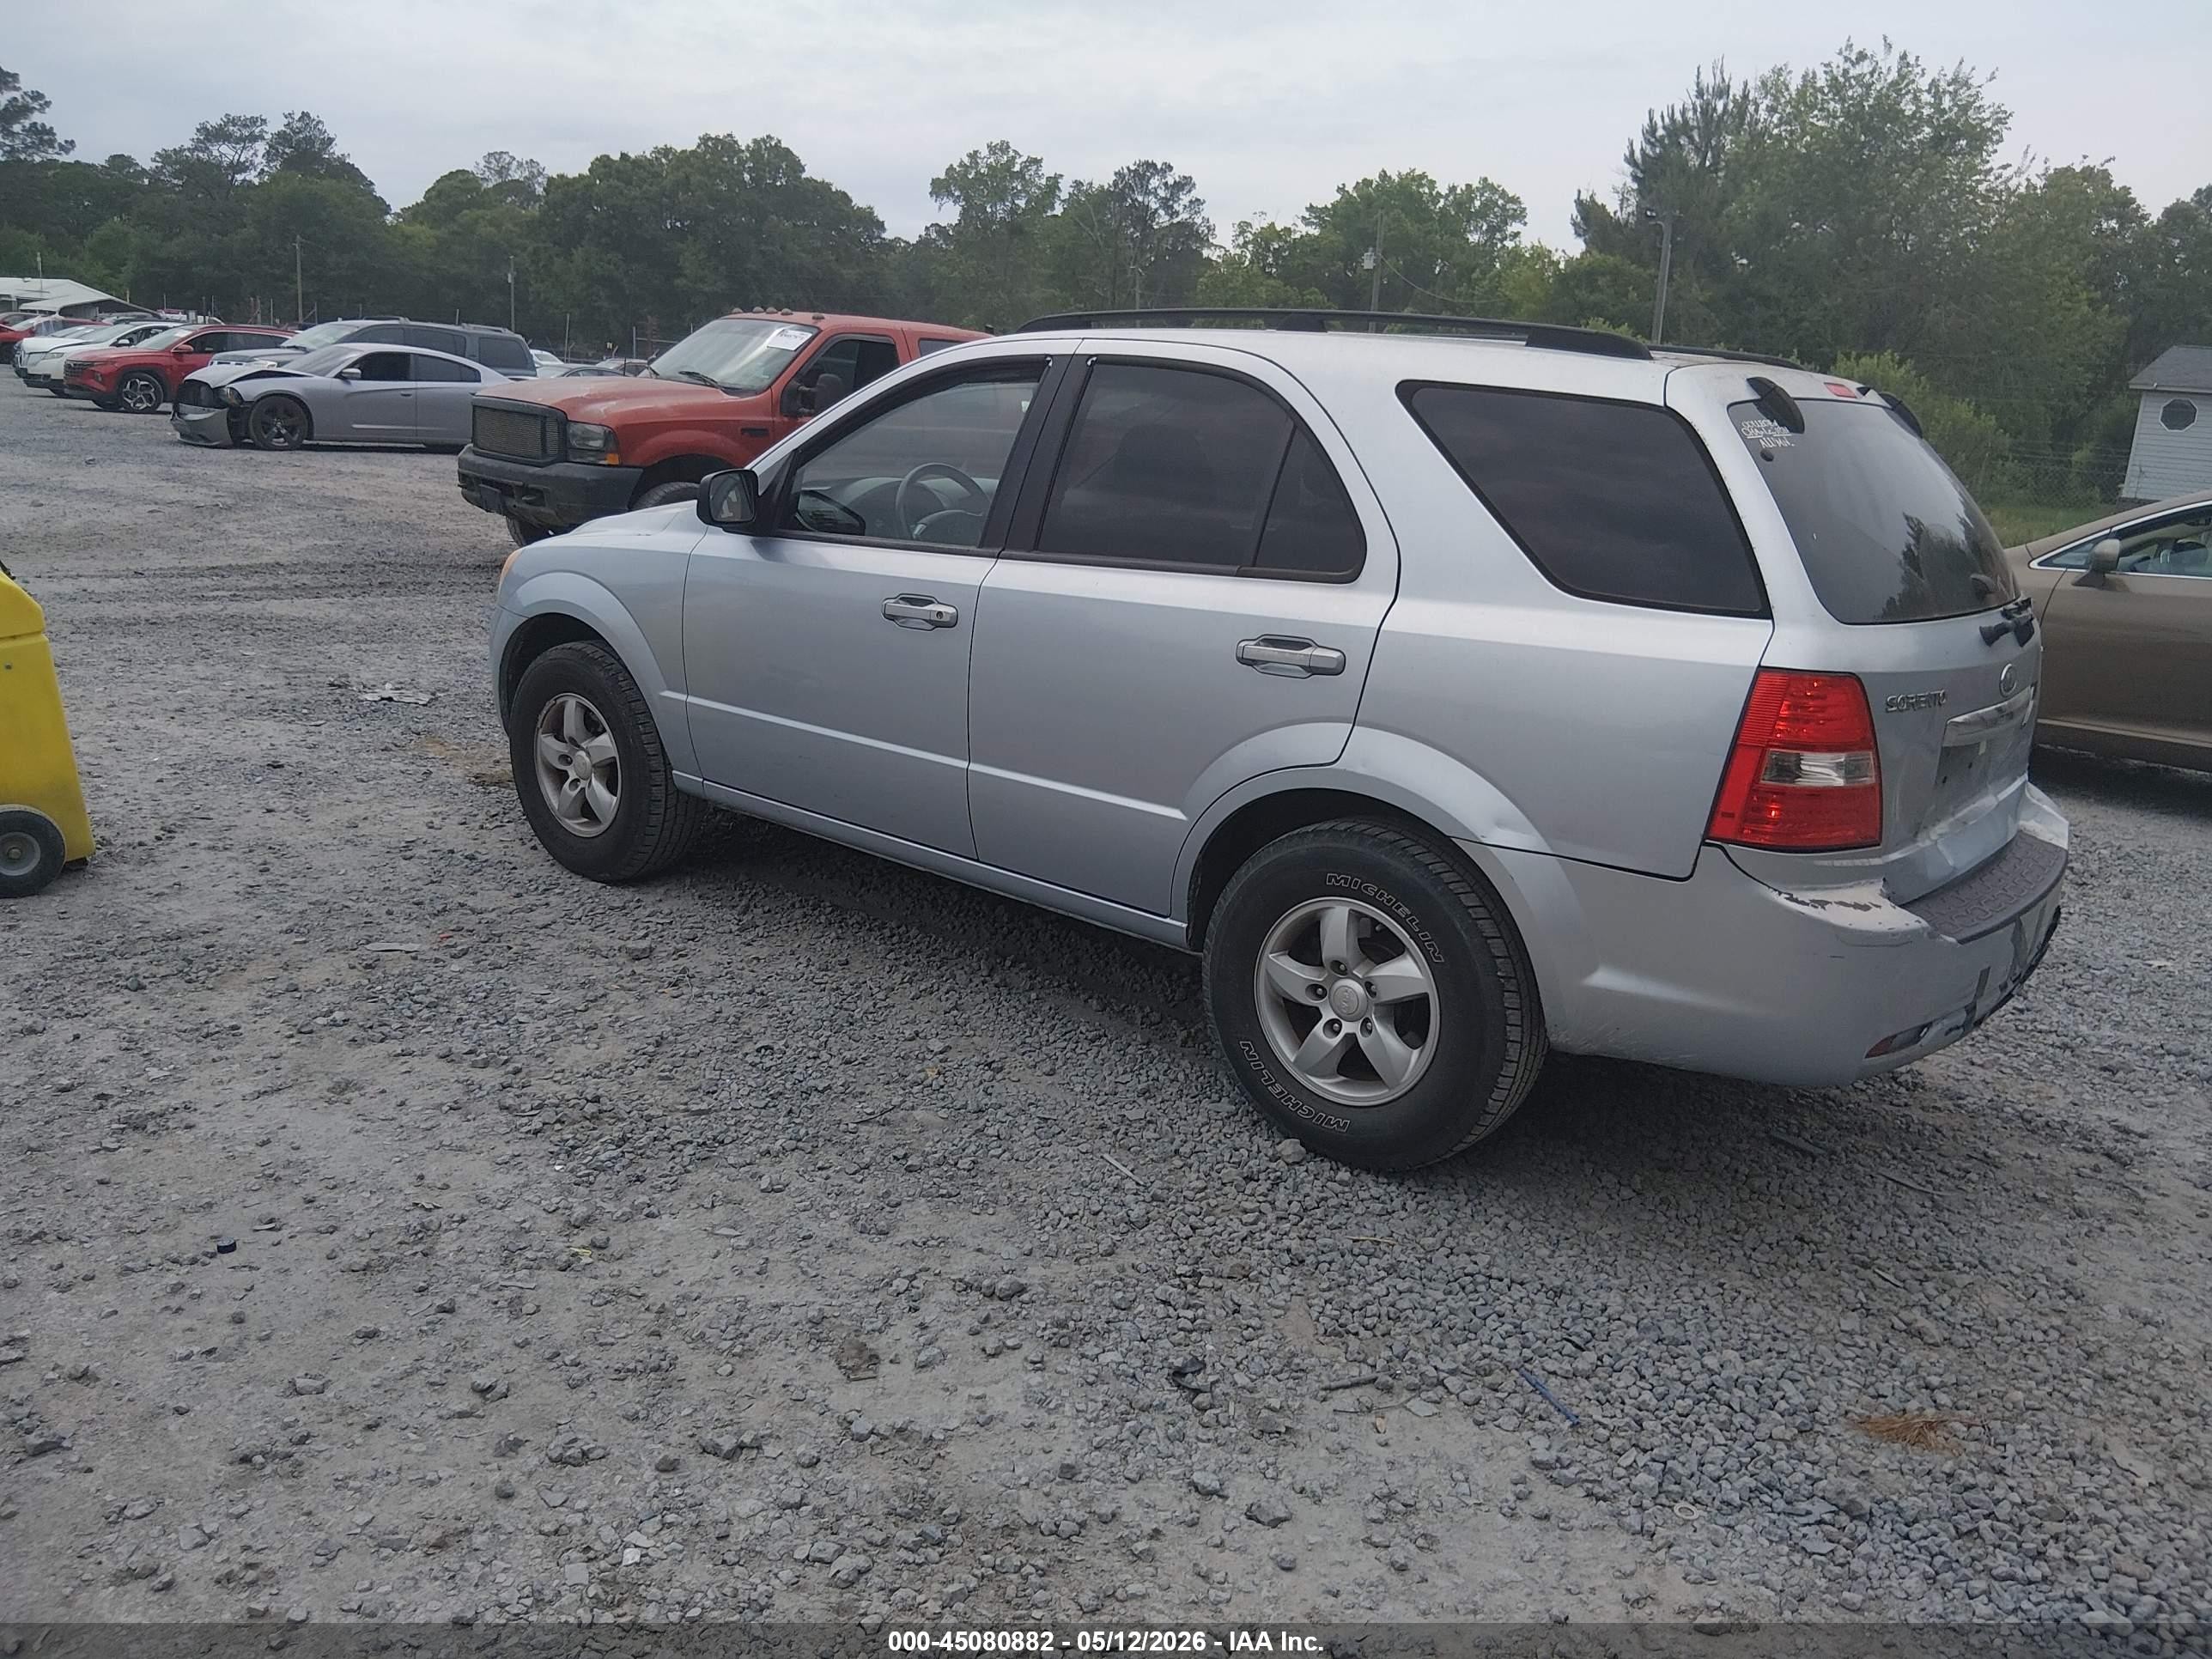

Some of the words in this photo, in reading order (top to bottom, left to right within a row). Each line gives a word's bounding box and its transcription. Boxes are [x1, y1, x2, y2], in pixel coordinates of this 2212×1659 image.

[1886, 690, 1947, 713] SORENTO
[1326, 873, 1444, 963] MICHELIN
[1239, 1041, 1351, 1133] MICHELIN
